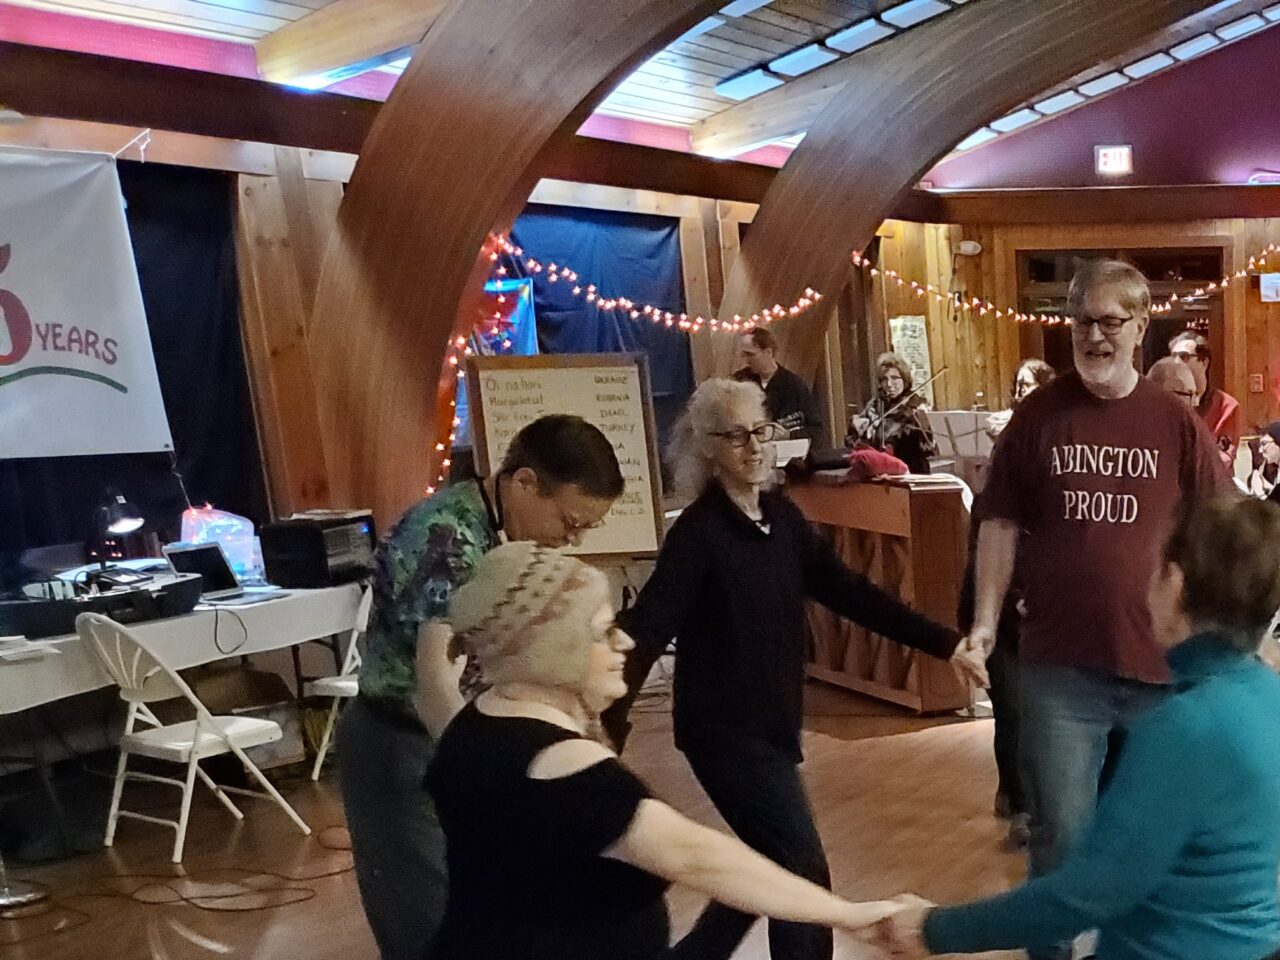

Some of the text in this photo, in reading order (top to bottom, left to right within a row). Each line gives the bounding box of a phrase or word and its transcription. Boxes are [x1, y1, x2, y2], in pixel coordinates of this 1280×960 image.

[35, 323, 118, 365] YEARS
[1051, 444, 1160, 479] ABINGTON
[1063, 490, 1138, 523] PROUD
